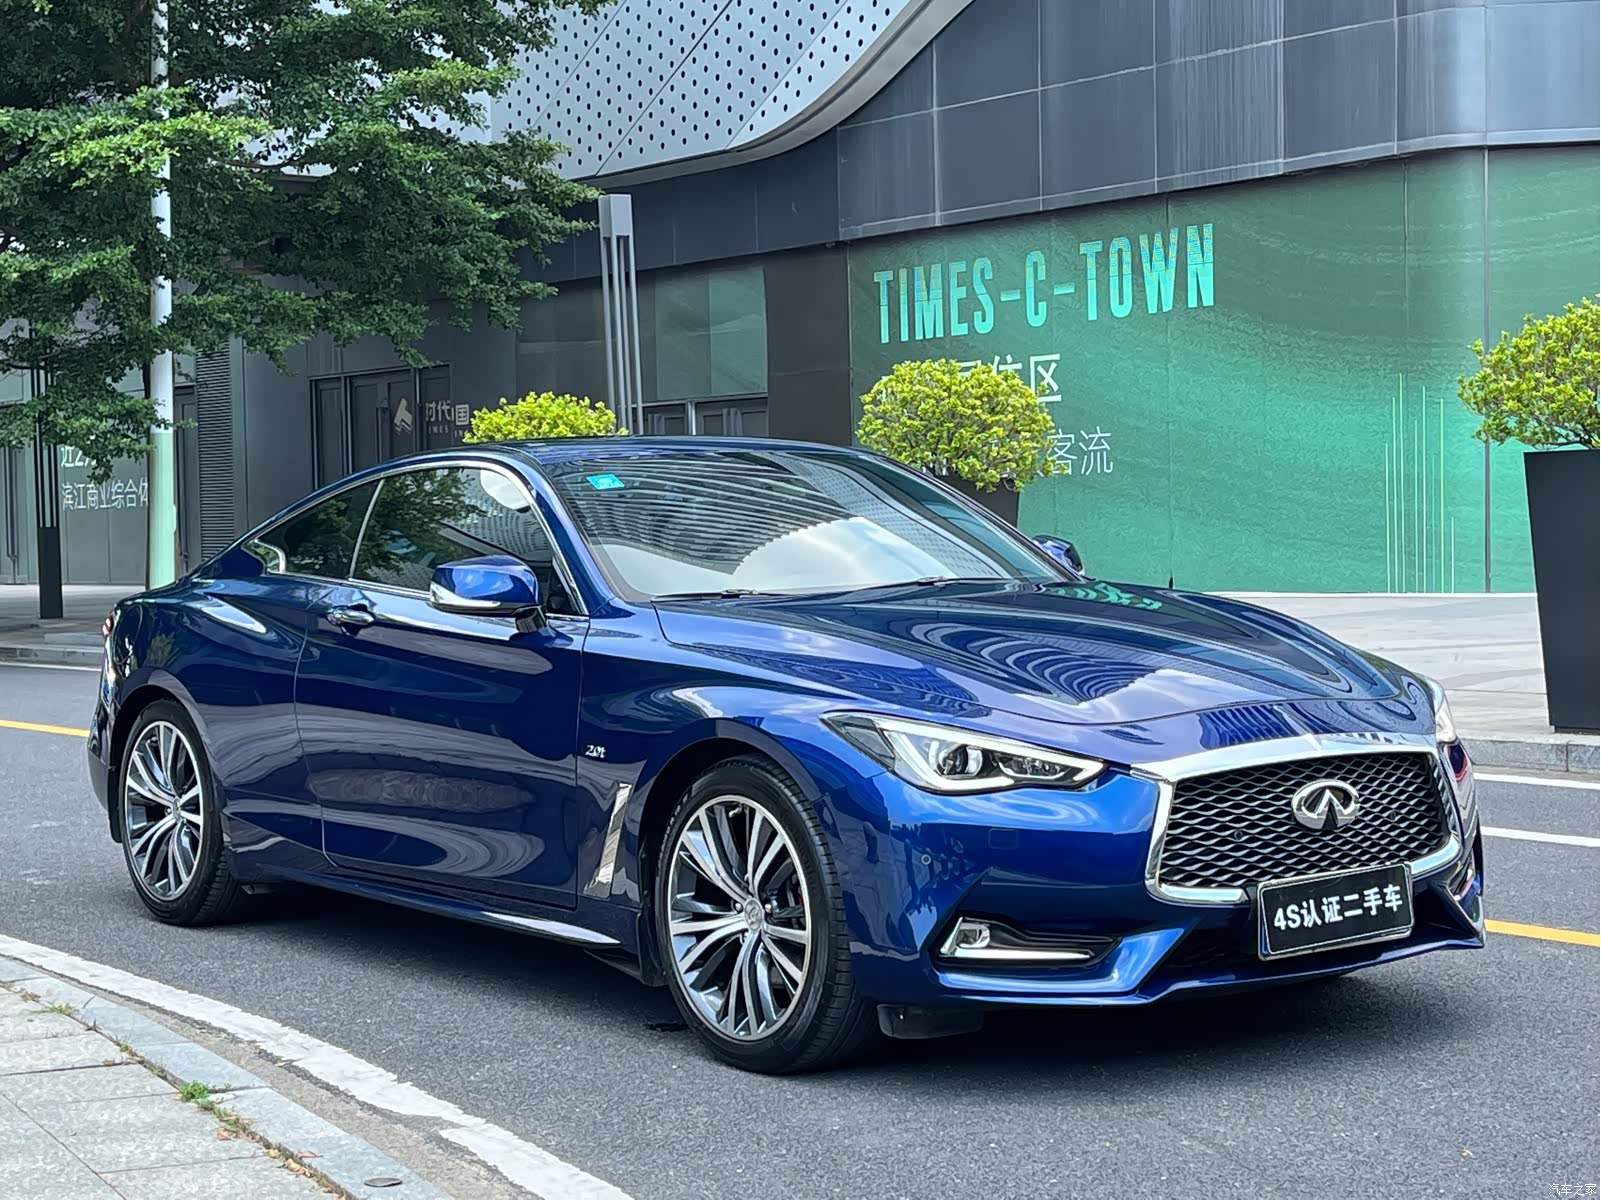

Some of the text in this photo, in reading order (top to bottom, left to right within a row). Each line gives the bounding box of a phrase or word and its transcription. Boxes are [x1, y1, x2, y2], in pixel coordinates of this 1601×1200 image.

[874, 223, 1214, 344] TIMES-C-TOWN
[425, 400, 469, 426] 时代国
[1273, 884, 1402, 931] 4S认证二手车
